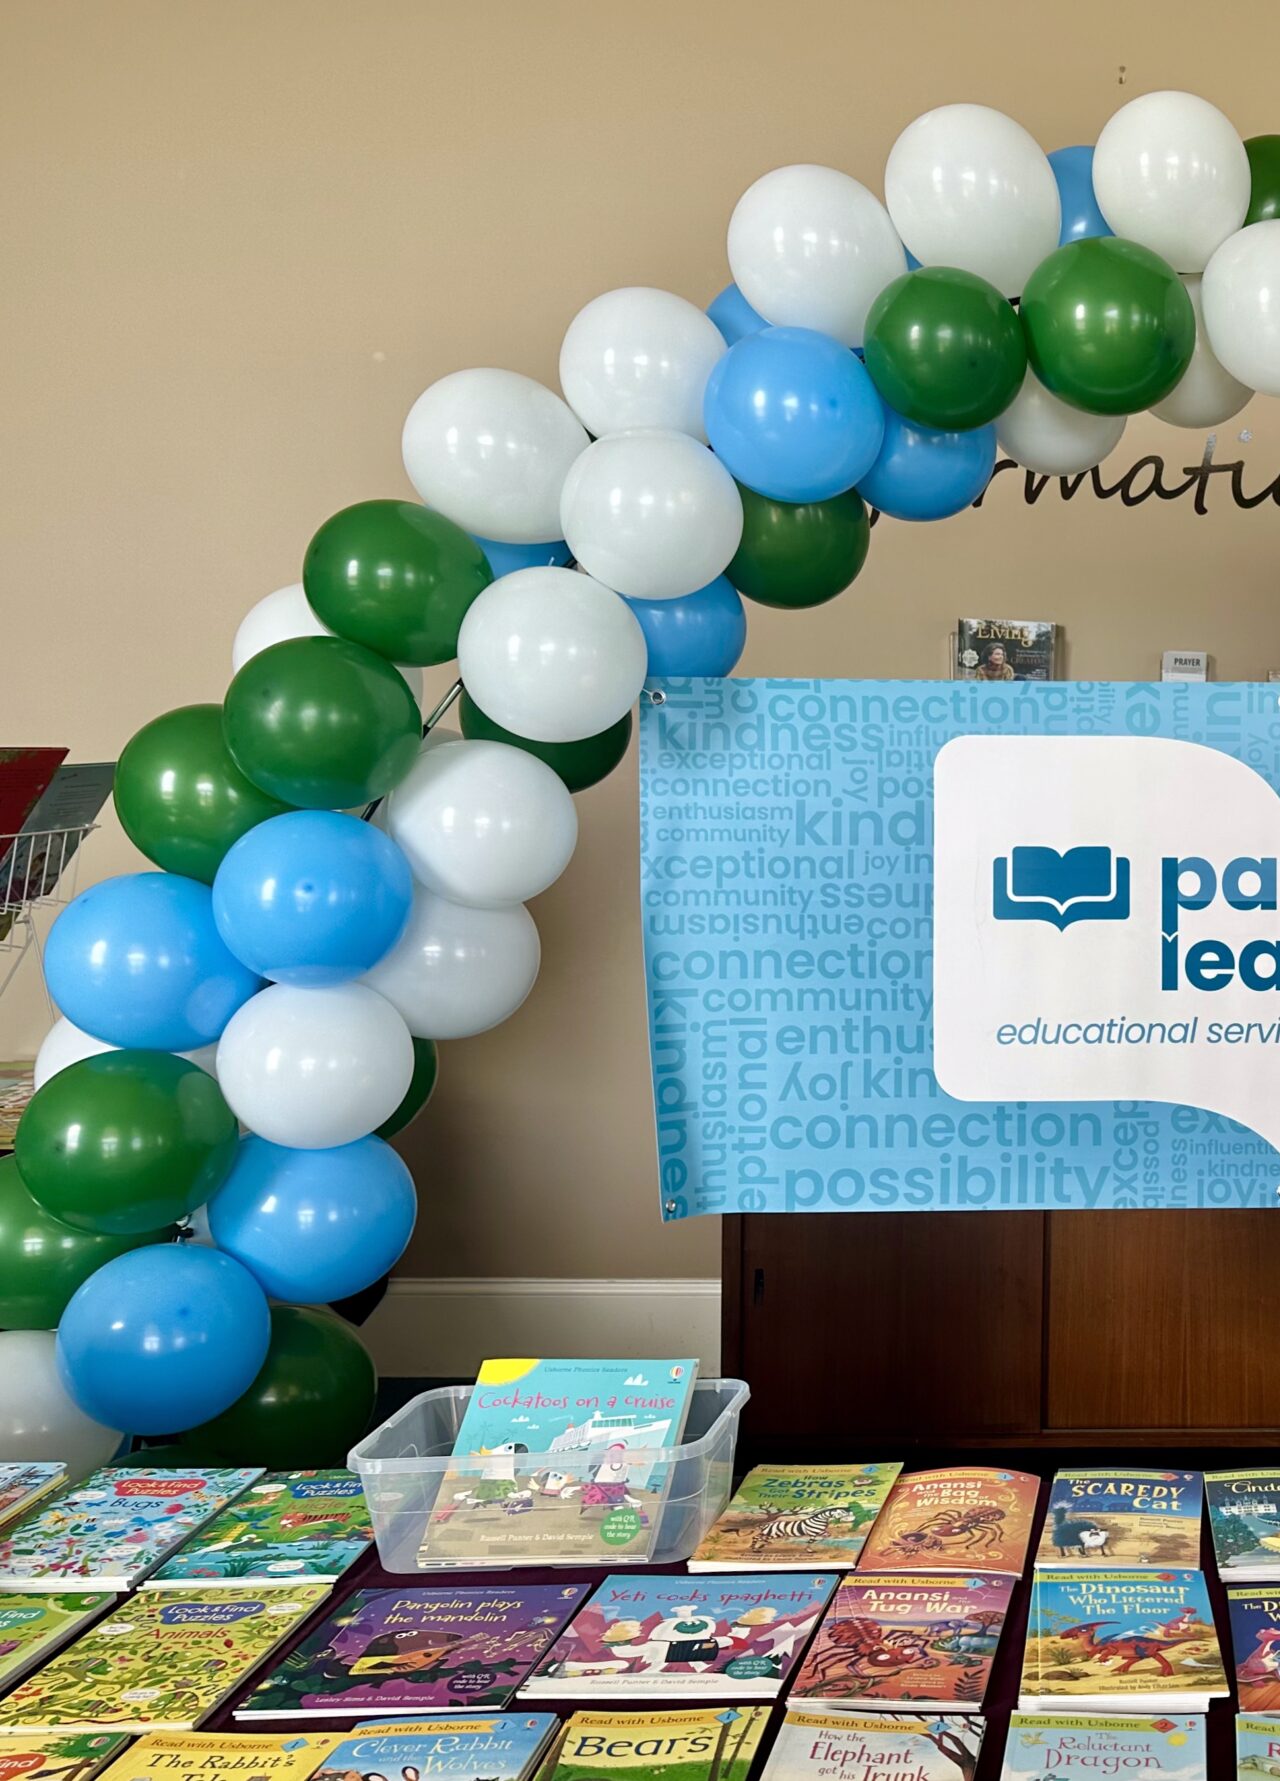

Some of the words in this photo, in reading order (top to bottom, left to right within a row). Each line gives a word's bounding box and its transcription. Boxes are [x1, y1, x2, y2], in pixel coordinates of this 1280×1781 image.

[1174, 657, 1201, 667] PRAYER
[768, 686, 1040, 725] connection
[658, 711, 885, 752] kindness
[658, 749, 831, 776] exceptional
[651, 773, 832, 797] connection
[652, 802, 794, 820] enthusiasm
[656, 824, 790, 848] community
[862, 850, 900, 876] joy
[645, 884, 815, 913] community
[650, 913, 865, 942] enthusiasm
[702, 980, 933, 1021] community
[996, 1016, 1198, 1046] educational
[769, 1104, 1102, 1151] connection
[784, 1152, 1111, 1211] possibility
[477, 1388, 568, 1410] Cockatoos
[576, 1396, 599, 1408] on
[606, 1396, 617, 1408] a
[624, 1394, 675, 1409] cruise
[165, 1480, 202, 1488] Find
[296, 1482, 331, 1490] Look
[763, 1478, 846, 1488] Zebras
[912, 1481, 981, 1492] Anansi
[792, 1488, 876, 1500] Stripes
[940, 1489, 980, 1499] Bag
[1071, 1483, 1186, 1499] SCAREDY
[111, 1498, 164, 1511] Bugs
[916, 1497, 997, 1507] Wisdom
[1132, 1497, 1182, 1511] Cat
[862, 1589, 950, 1601] Anansi
[1080, 1583, 1190, 1595] Dinosaur
[610, 1589, 648, 1602] Yeti
[656, 1590, 709, 1602] cooks
[720, 1589, 813, 1606] spaghetti
[1069, 1595, 1107, 1605] Who
[1111, 1595, 1185, 1605] Littered
[168, 1605, 207, 1614] Look
[221, 1604, 259, 1613] Find
[392, 1598, 473, 1613] Pangolin
[478, 1599, 525, 1613] plays
[869, 1601, 912, 1615] Tug
[925, 1603, 978, 1614] War
[1082, 1605, 1115, 1615] The
[1123, 1604, 1171, 1614] Floor
[172, 1613, 233, 1622] Puzzles
[384, 1613, 413, 1624] the
[420, 1611, 508, 1623] mandolin
[140, 1627, 231, 1640] Animals
[580, 1716, 612, 1725] Read
[617, 1715, 646, 1724] with
[650, 1714, 704, 1724] Usborne
[797, 1715, 827, 1725] Read
[831, 1717, 858, 1728] with
[863, 1721, 914, 1731] Usborne
[1020, 1717, 1047, 1728] Read
[1050, 1717, 1084, 1728] with
[1088, 1718, 1141, 1729] Usborne
[1246, 1722, 1274, 1731] Read
[427, 1722, 482, 1734] Usborne
[819, 1730, 843, 1741] How
[846, 1732, 865, 1742] the
[182, 1738, 216, 1750] with
[220, 1739, 273, 1750] Usborne
[352, 1738, 428, 1758] Clever
[432, 1736, 514, 1755] Rabbit
[573, 1731, 716, 1758] Bears
[1058, 1735, 1153, 1753] Reluctant
[147, 1753, 192, 1769] The
[199, 1753, 296, 1769] Rabbit's
[809, 1741, 913, 1767] Elephant
[1045, 1749, 1163, 1774] Dragon
[422, 1753, 507, 1774] Wolves
[862, 1765, 930, 1781] Trunk
